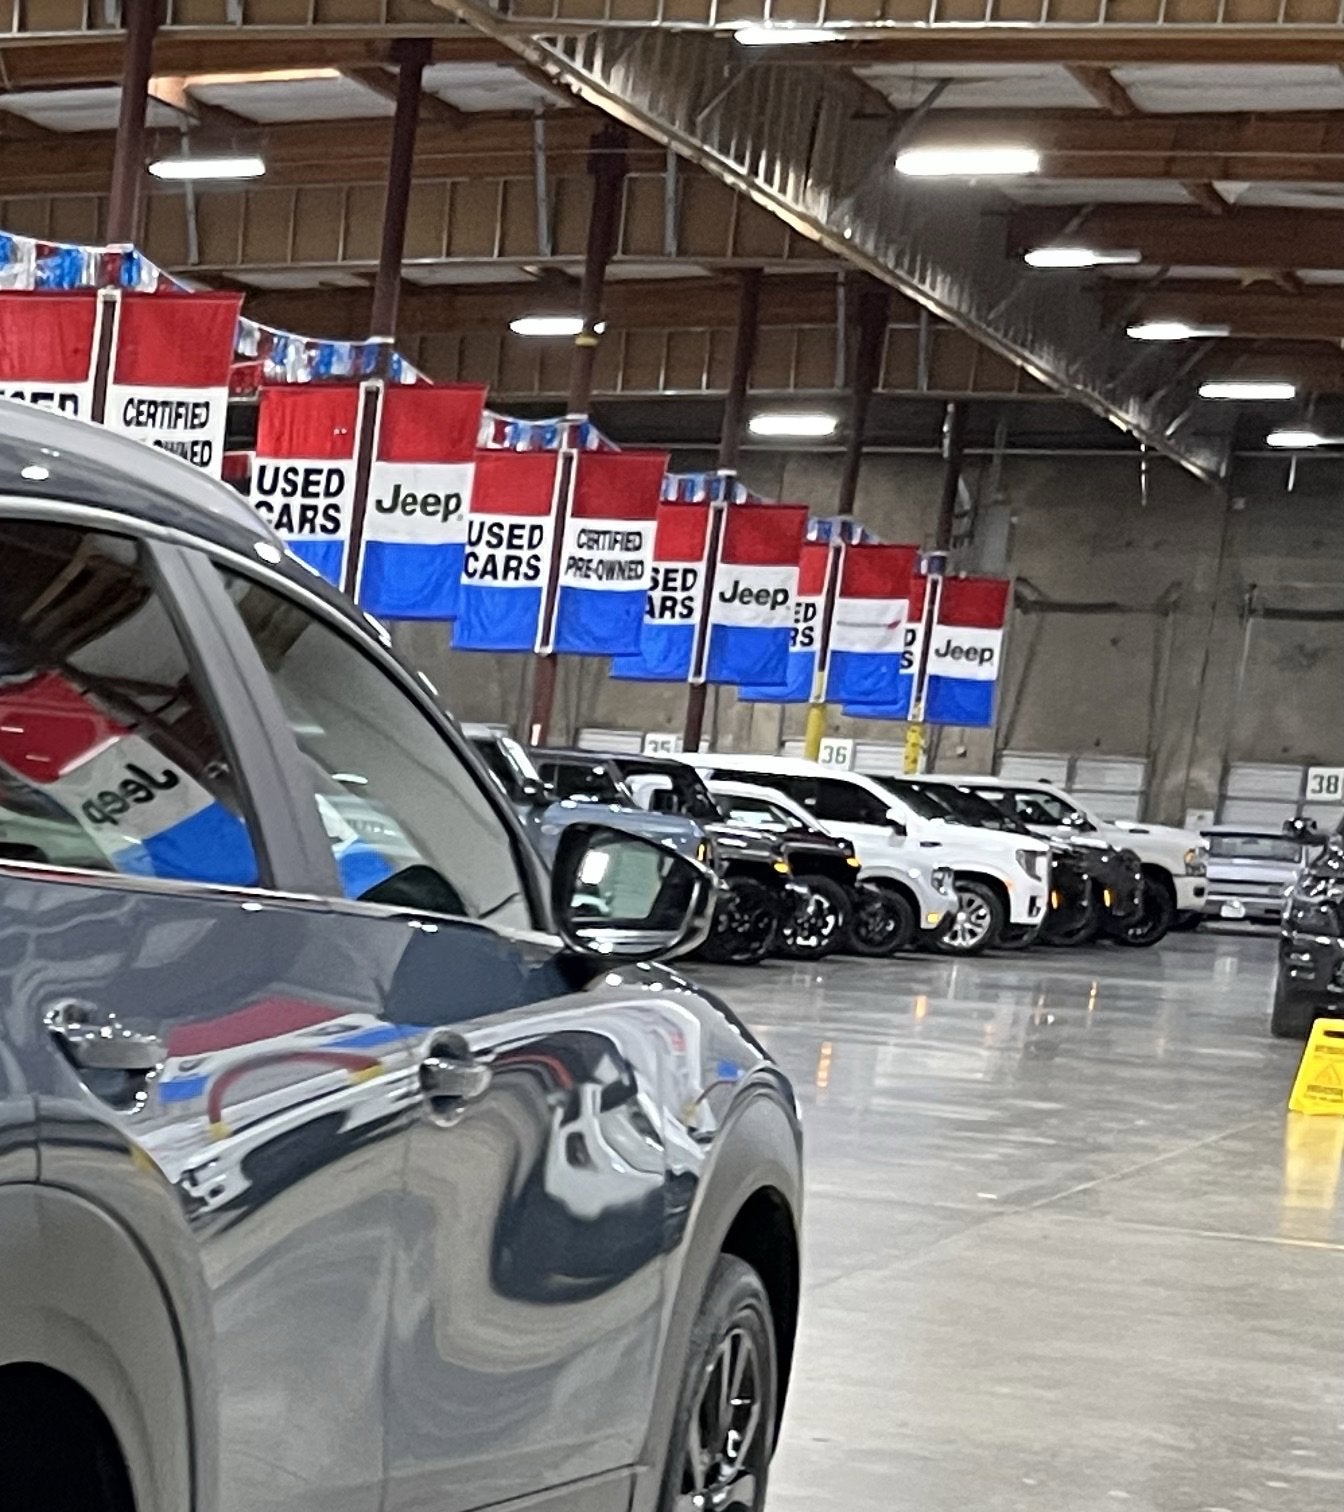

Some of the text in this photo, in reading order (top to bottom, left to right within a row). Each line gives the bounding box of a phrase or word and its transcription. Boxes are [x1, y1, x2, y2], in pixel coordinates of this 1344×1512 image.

[123, 397, 210, 430] CERTIFIED
[256, 465, 345, 499] USED
[375, 483, 462, 523] Jeep
[468, 520, 544, 551] USED
[576, 528, 643, 552] CERTIFIED
[464, 551, 542, 582] CARS
[564, 555, 645, 582] PRE-OWNED
[649, 567, 698, 592] SED
[718, 580, 789, 611] Jeep
[934, 639, 995, 666] Jeep
[821, 744, 848, 765] 36
[1310, 774, 1340, 795] 38
